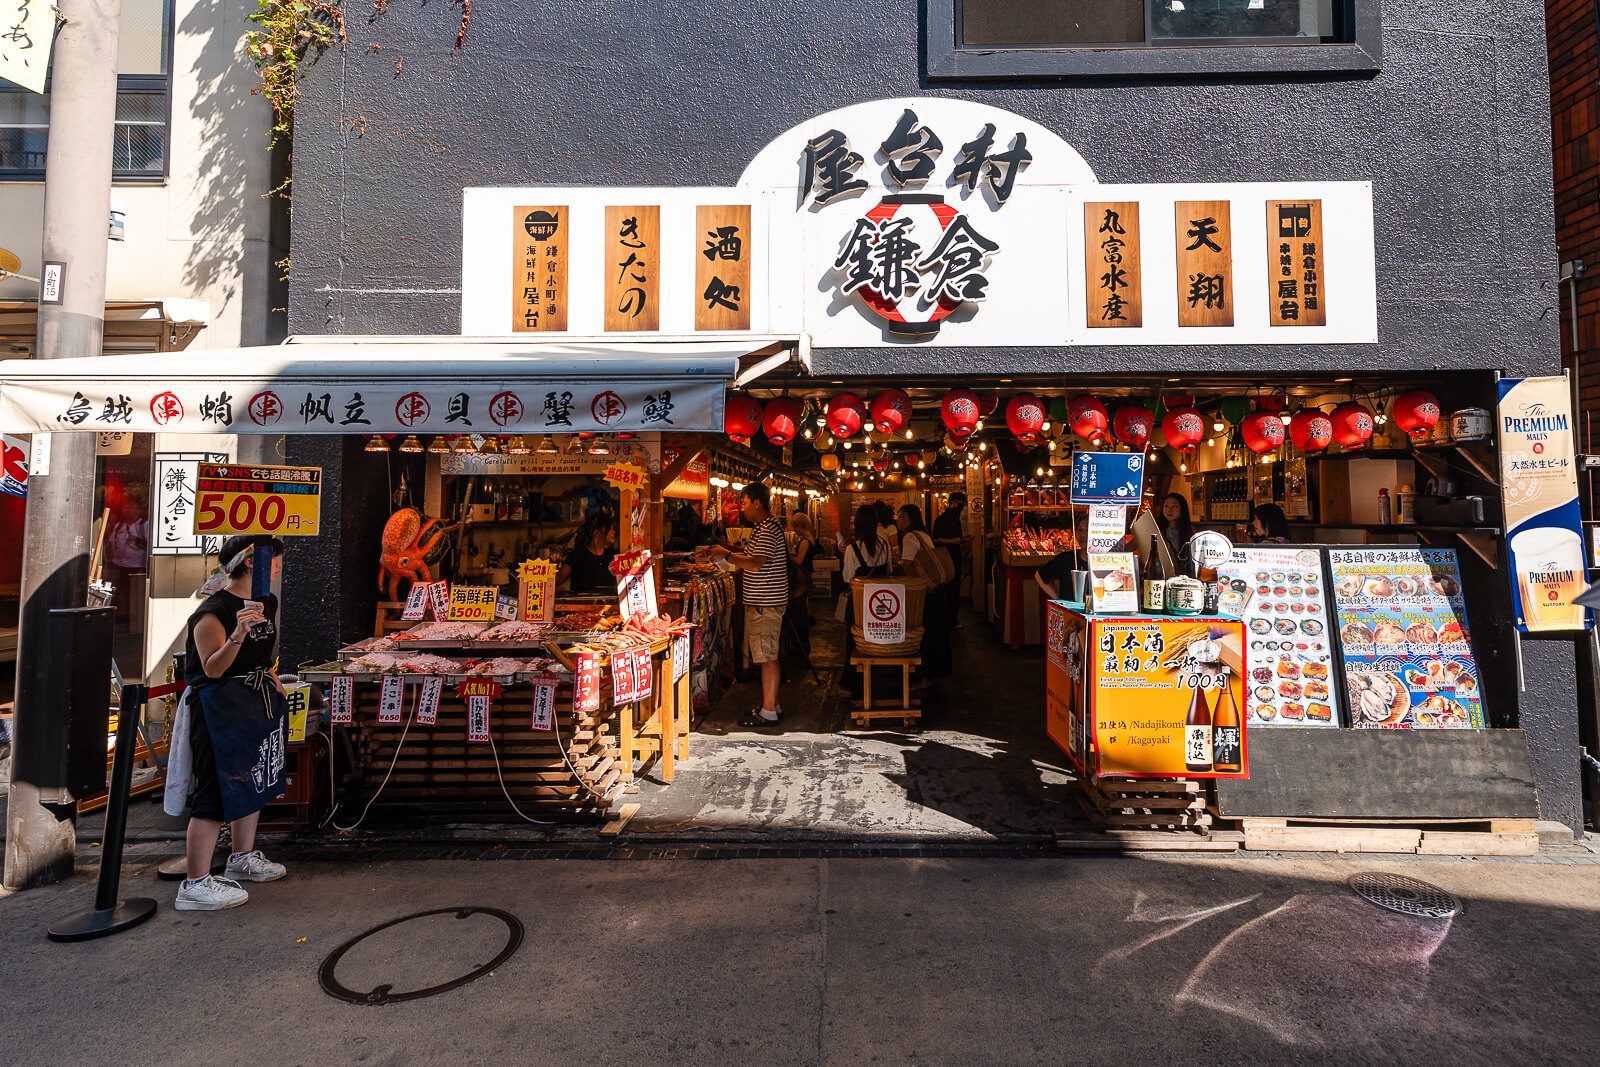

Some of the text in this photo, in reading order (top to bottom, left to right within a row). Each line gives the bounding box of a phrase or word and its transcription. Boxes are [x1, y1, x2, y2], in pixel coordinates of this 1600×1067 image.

[802, 108, 1033, 205] 屋台村
[618, 216, 647, 319] きたの
[834, 214, 1000, 303] 鎌倉
[1098, 208, 1129, 320] 丸富水産
[1185, 216, 1225, 310] 天翔
[702, 226, 741, 311] 酒処
[523, 245, 540, 328] 海鮮丼屋台
[545, 245, 558, 315] 鎌倉小町通
[300, 392, 372, 426] 帆立
[444, 392, 472, 427] 貝
[539, 390, 575, 427] 蟹
[641, 390, 675, 425] 鰻
[1519, 403, 1551, 417] The
[1504, 413, 1569, 432] PREMIUM
[485, 457, 517, 466] Carefully
[520, 458, 538, 466] grill
[1510, 458, 1569, 472] 天然水生ビール
[1332, 551, 1457, 564] 当店自慢の海鮮焼き各種
[1529, 570, 1574, 584] PREMIUM
[452, 589, 494, 605] 海鮮串
[1103, 625, 1139, 633] japanese
[1100, 632, 1164, 654] 日本酒
[1104, 655, 1198, 673] 最初の一杯
[1177, 674, 1225, 689] 100円
[387, 678, 399, 711] たこ串
[417, 715, 435, 723] ¥700
[1127, 735, 1170, 747] /Kagayaki
